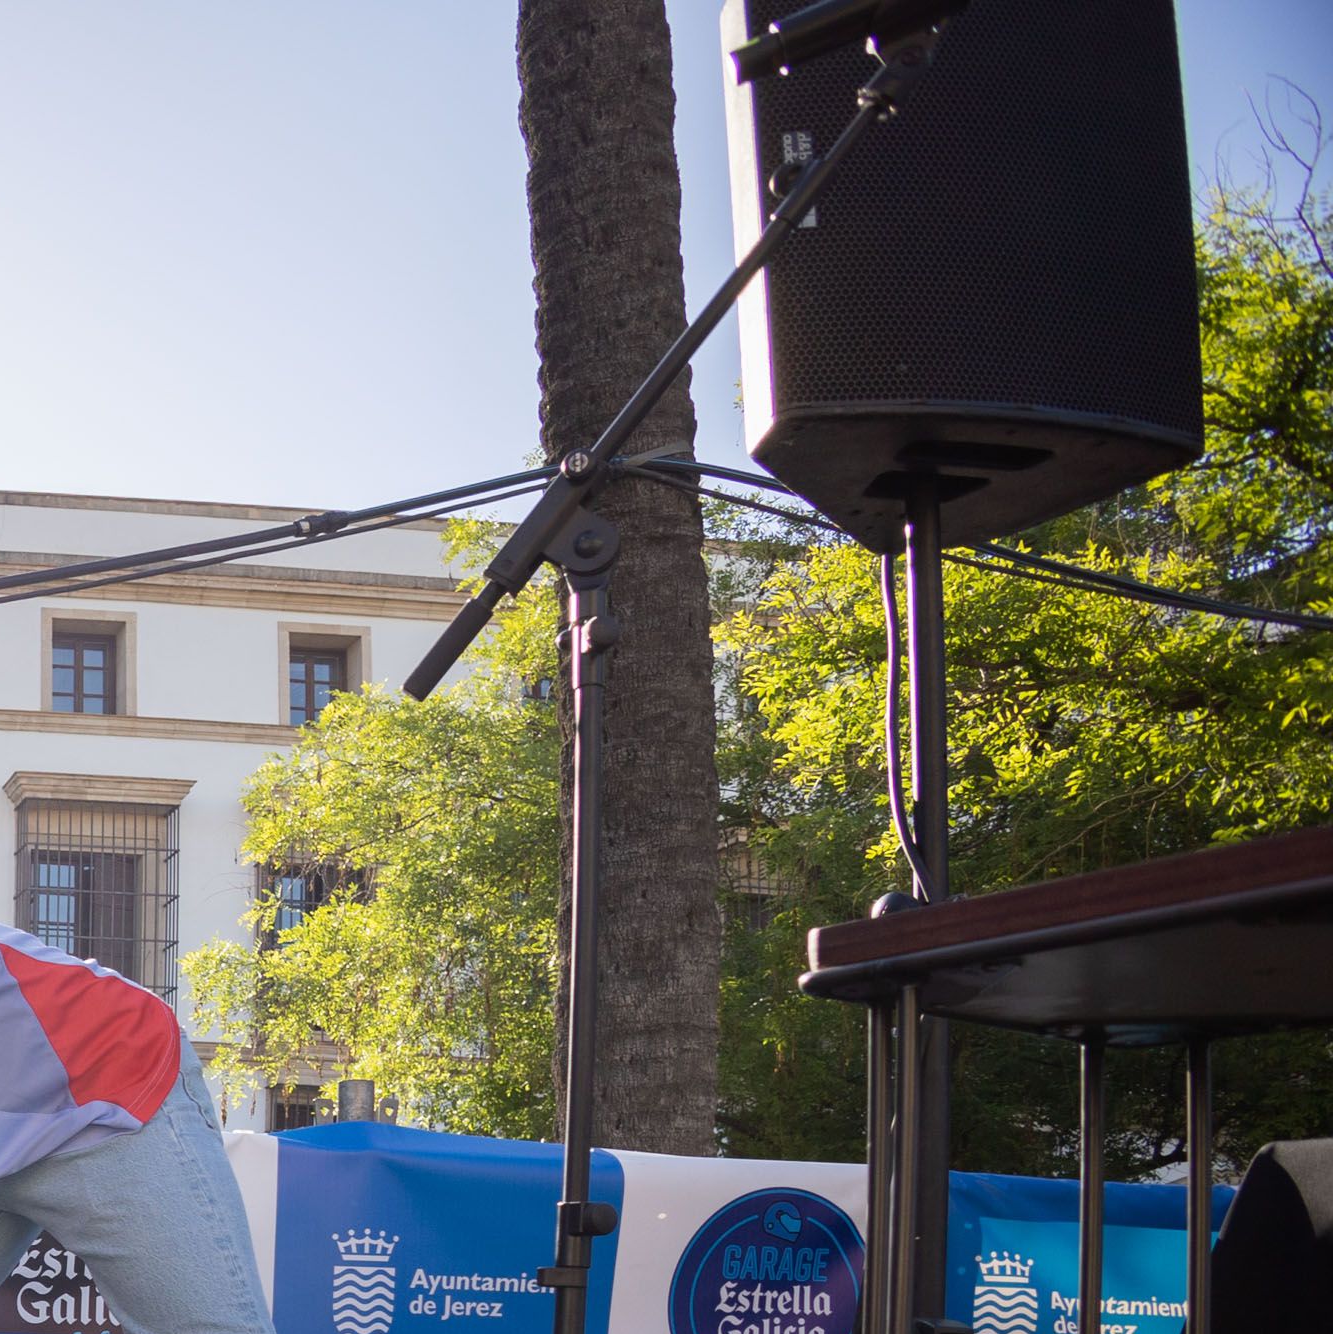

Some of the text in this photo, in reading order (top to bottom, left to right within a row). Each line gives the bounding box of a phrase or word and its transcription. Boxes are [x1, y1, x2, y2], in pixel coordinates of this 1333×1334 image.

[722, 1244, 830, 1282] GARAGE
[409, 1267, 555, 1296] Ayuntamie
[16, 1280, 122, 1327] Gali
[408, 1294, 503, 1321] de Jerez
[714, 1280, 833, 1316] Estrella
[1053, 1314, 1078, 1334] de
